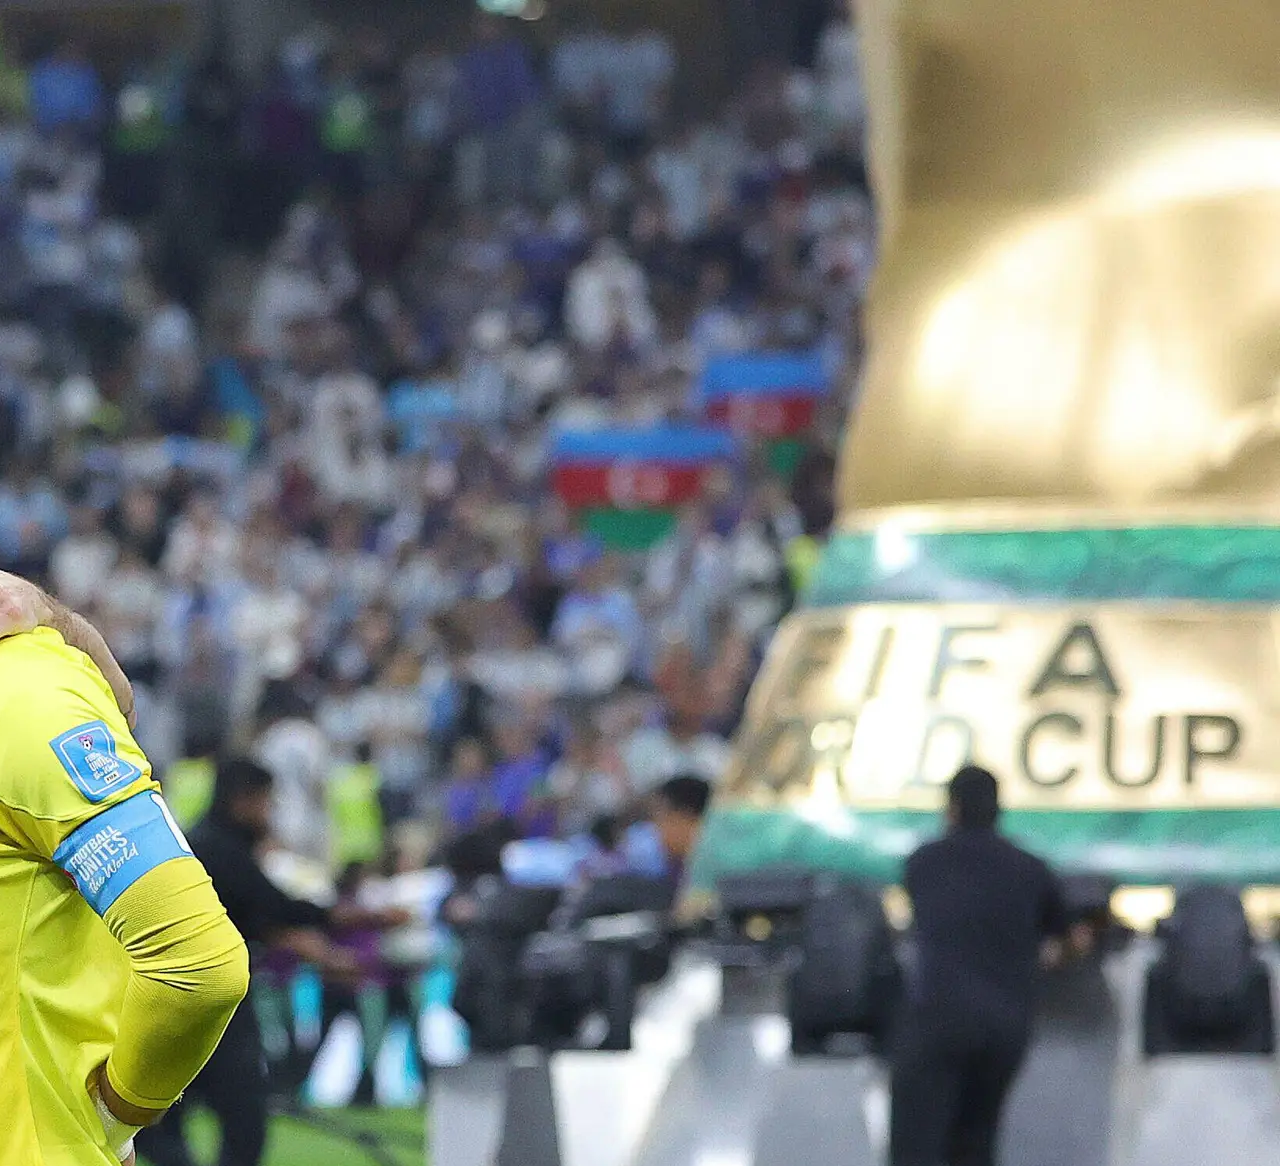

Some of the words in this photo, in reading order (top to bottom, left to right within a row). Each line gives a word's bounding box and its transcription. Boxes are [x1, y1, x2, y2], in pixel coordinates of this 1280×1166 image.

[1020, 712, 1242, 788] CUP
[69, 825, 120, 869] FOOTBALL
[77, 831, 128, 881] UNITES
[102, 842, 139, 878] World
